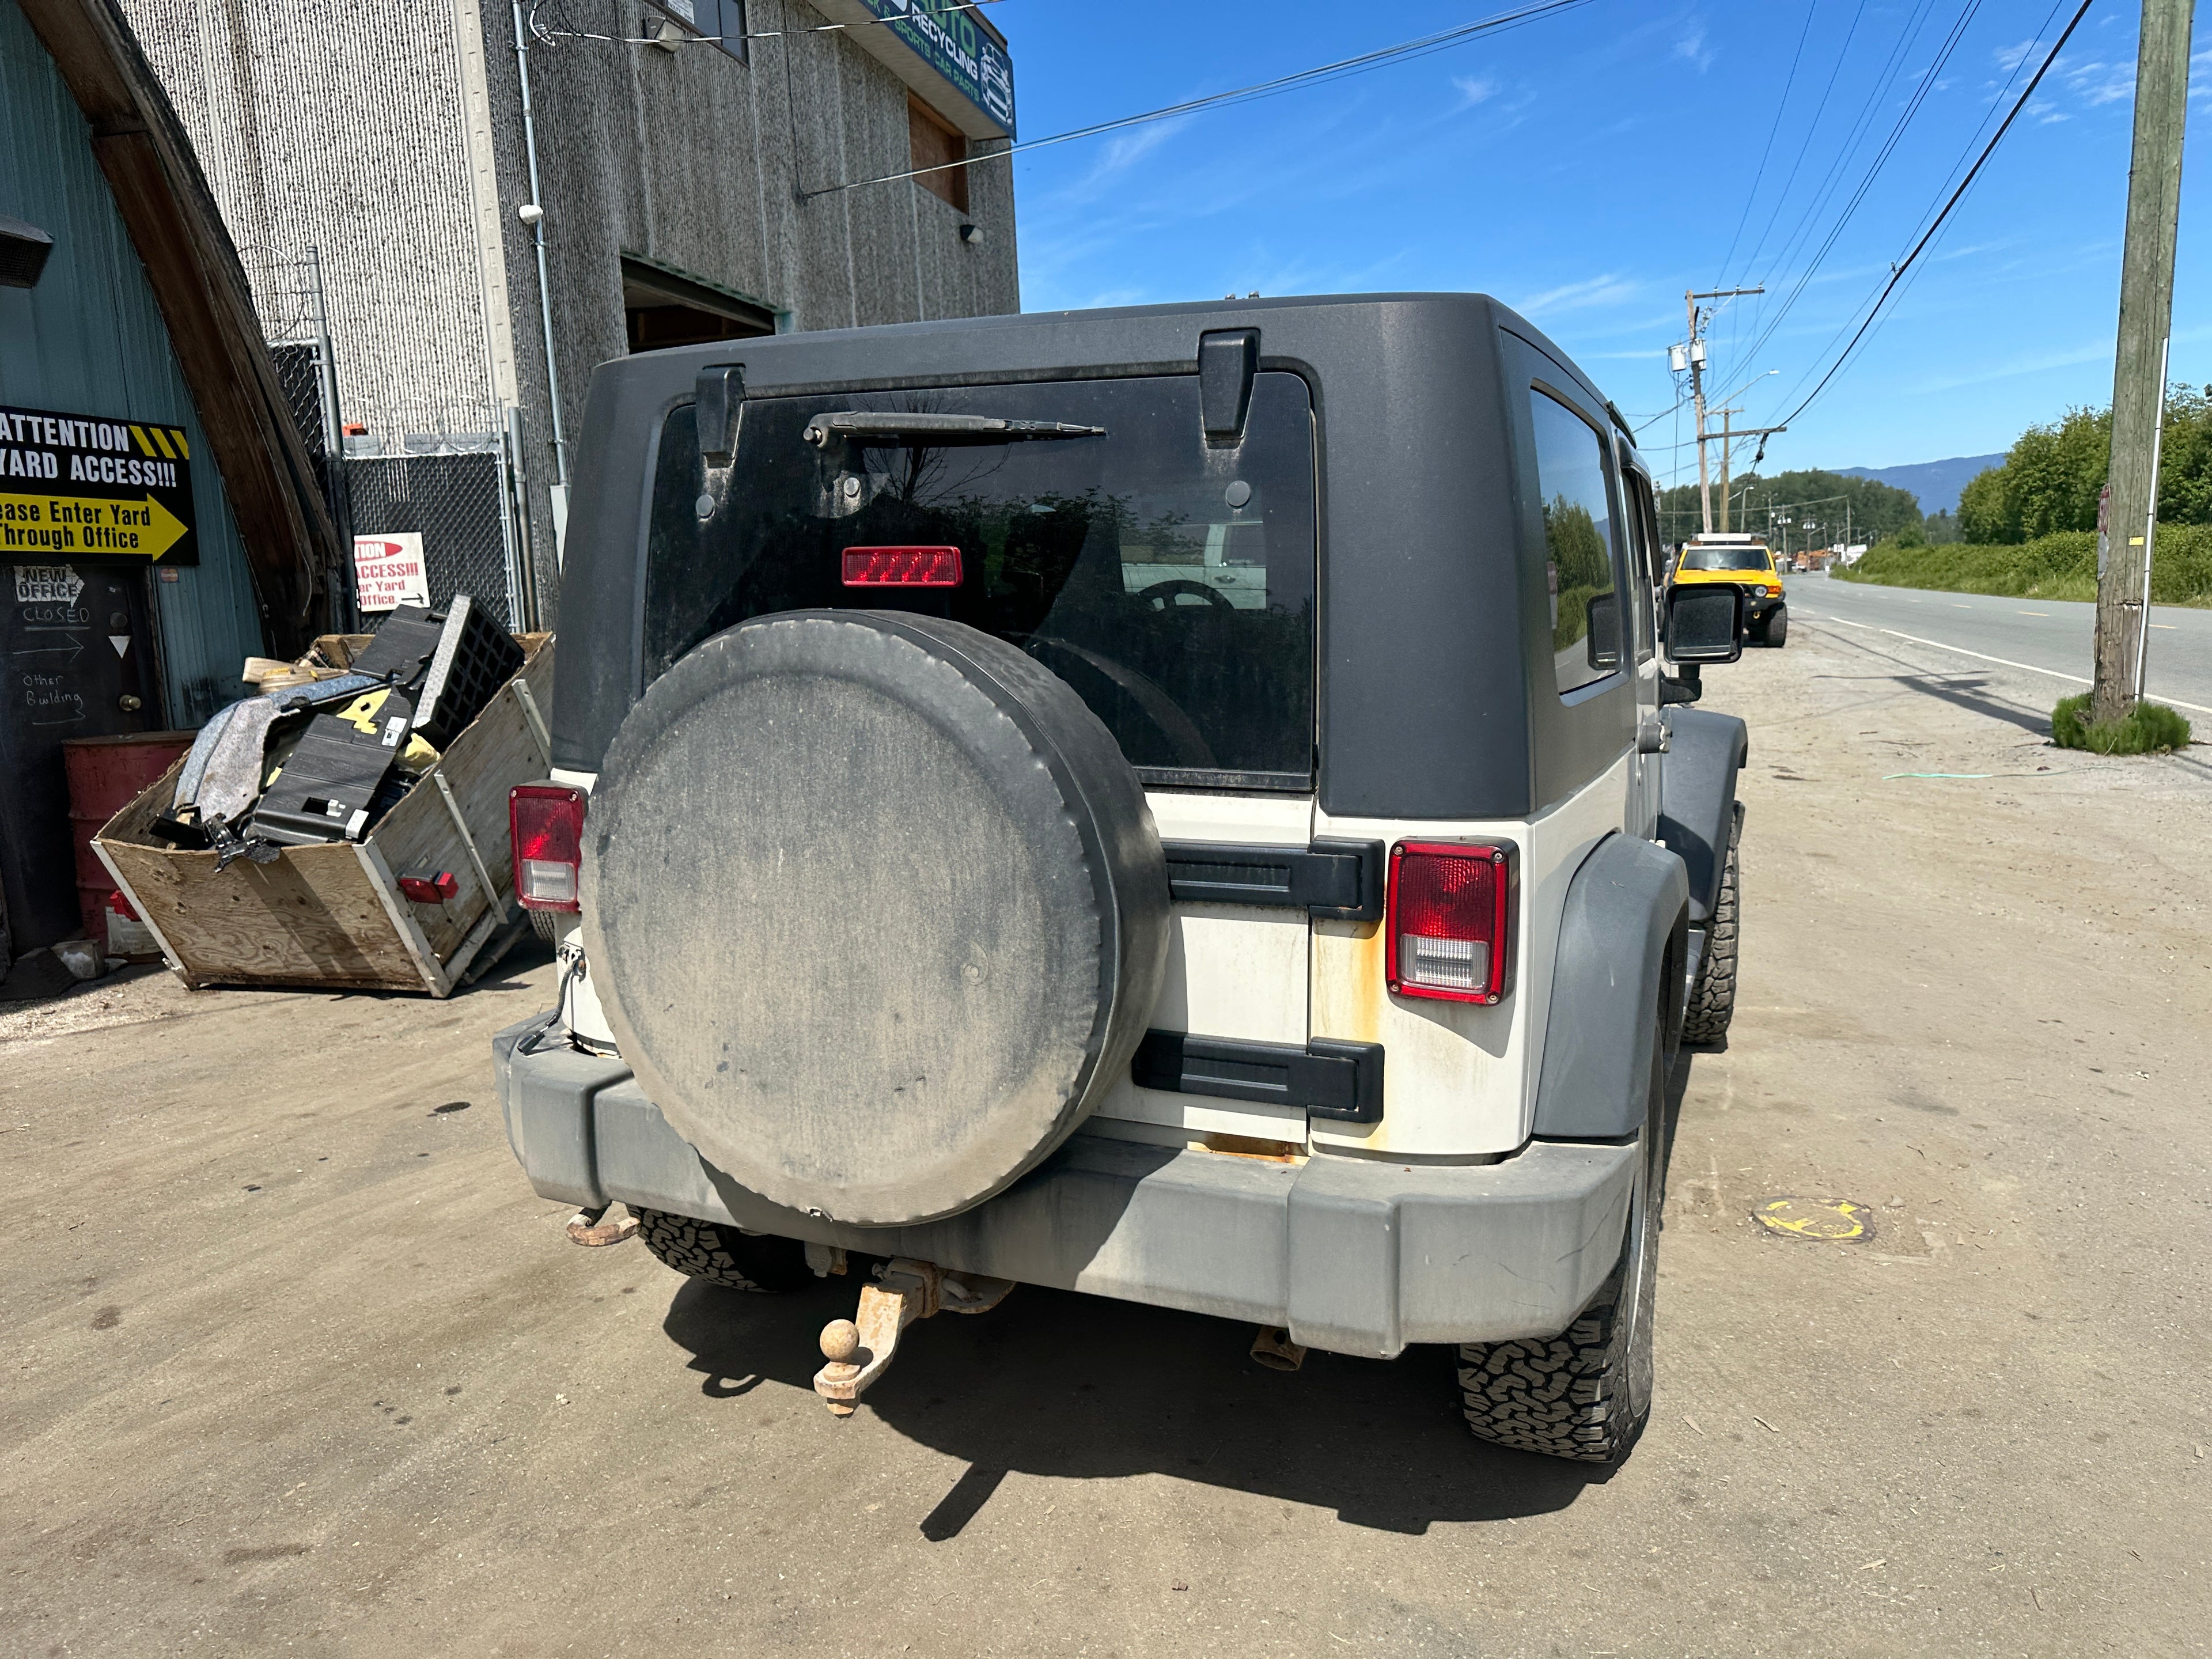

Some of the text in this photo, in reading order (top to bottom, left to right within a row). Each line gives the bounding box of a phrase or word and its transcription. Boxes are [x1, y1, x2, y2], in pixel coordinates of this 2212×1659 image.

[911, 2, 978, 81] RECYCLING
[895, 19, 930, 58] SPORTS
[934, 51, 952, 78] CAR
[953, 69, 979, 102] PARTS
[0, 412, 130, 452] ATTENTION
[70, 455, 176, 487] ACCESS!!!
[50, 501, 101, 524] Enter
[110, 504, 150, 526] Yard
[83, 526, 139, 548] Office
[25, 568, 67, 582] NEW
[375, 580, 406, 592] Yard
[18, 581, 79, 599] OFFICE
[23, 607, 89, 623] CLOSED
[26, 690, 84, 709] Building
